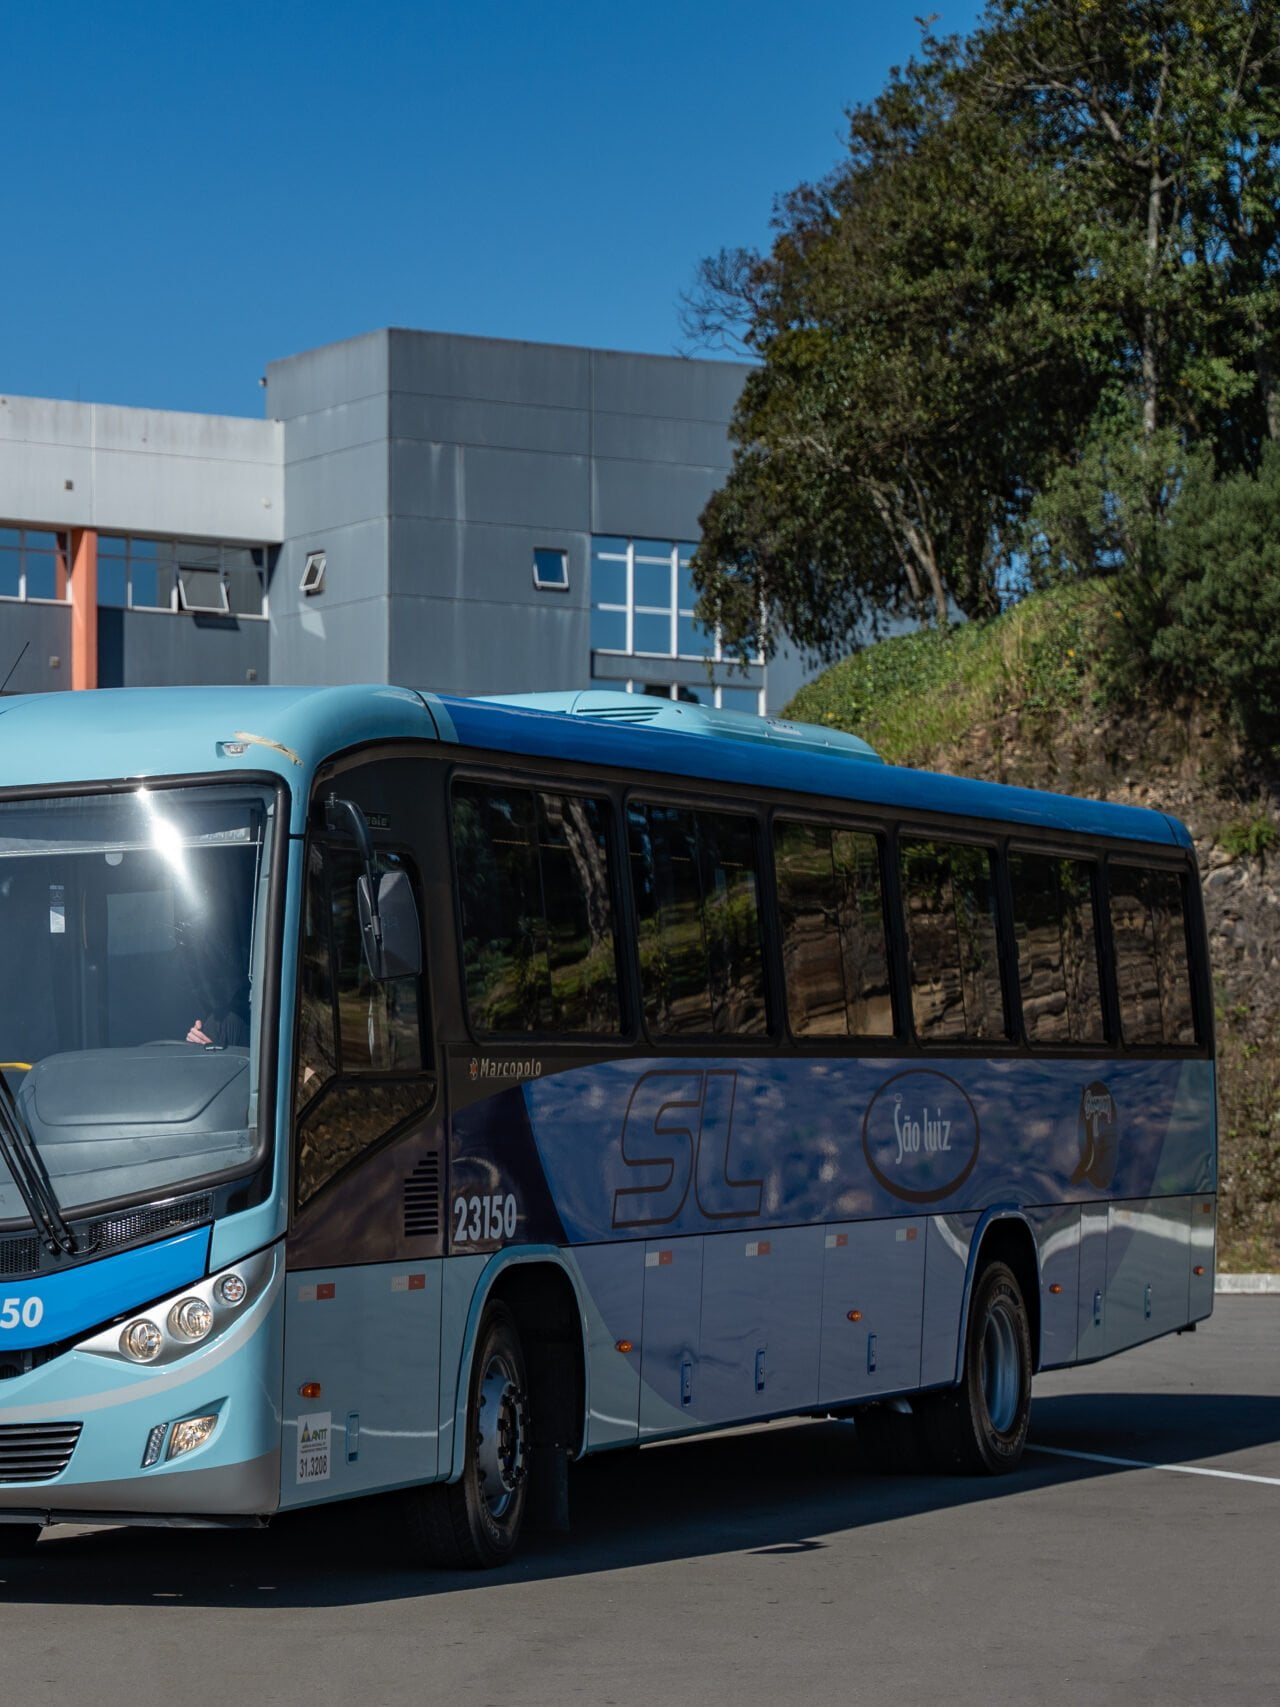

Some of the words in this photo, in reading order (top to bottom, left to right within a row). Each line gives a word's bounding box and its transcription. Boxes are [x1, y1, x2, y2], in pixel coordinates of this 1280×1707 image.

[480, 1058, 542, 1080] Marcopolo
[612, 1069, 764, 1229] SL
[894, 1100, 920, 1164] São
[453, 1193, 517, 1242] 23150
[312, 1428, 328, 1441] ANTT
[299, 1454, 328, 1478] 31.3208
